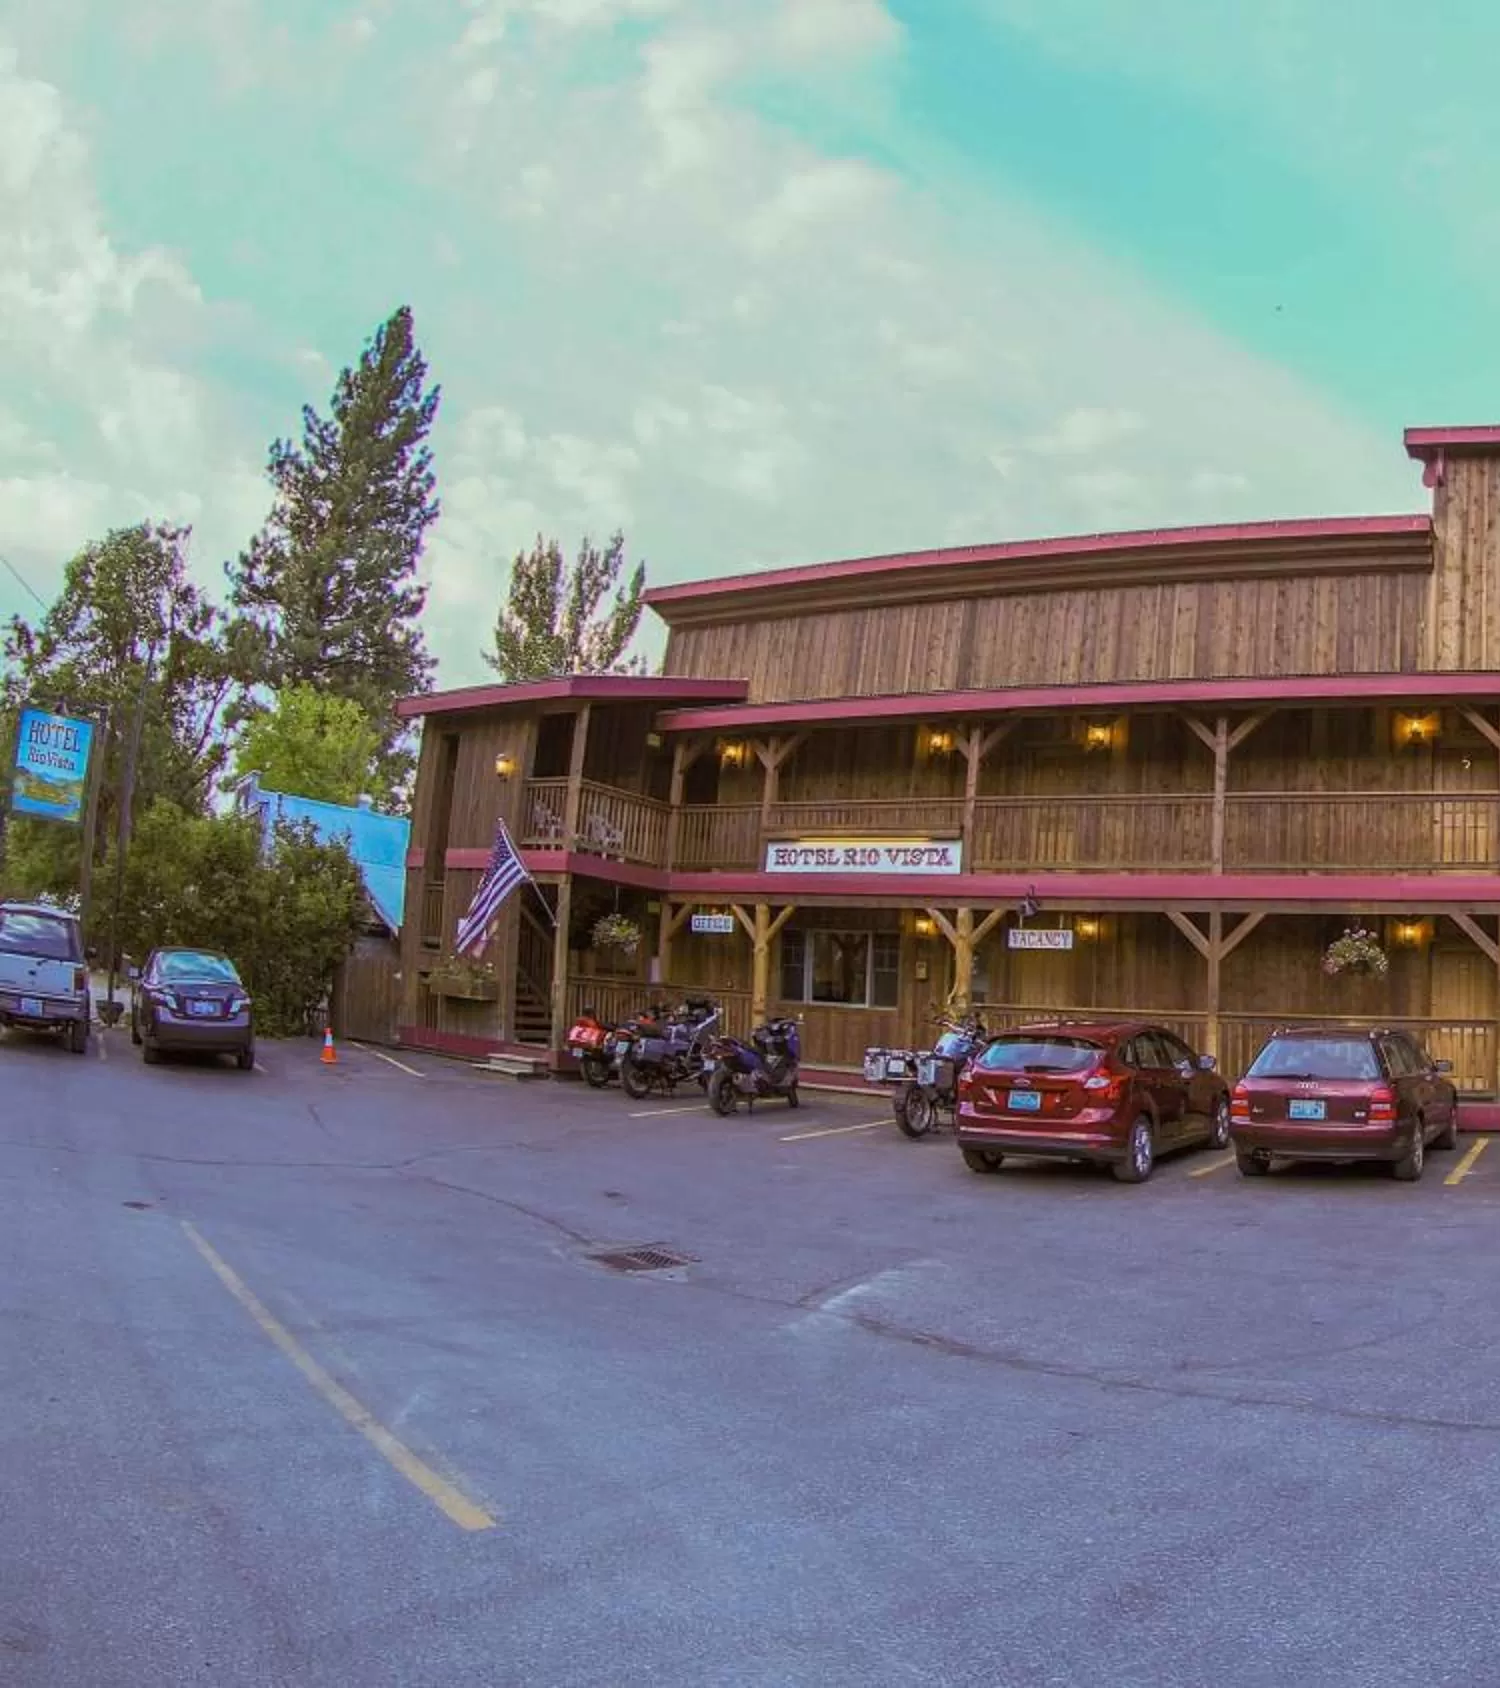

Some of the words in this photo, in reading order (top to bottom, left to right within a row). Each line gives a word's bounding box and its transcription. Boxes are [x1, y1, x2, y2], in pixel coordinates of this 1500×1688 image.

[28, 719, 81, 753] HOTEL
[28, 745, 47, 765] Rio
[47, 751, 76, 771] Vista
[773, 847, 840, 866] HOTEL
[843, 848, 881, 866] RIO
[885, 847, 953, 867] VISTA
[1011, 930, 1071, 947] VACANCY
